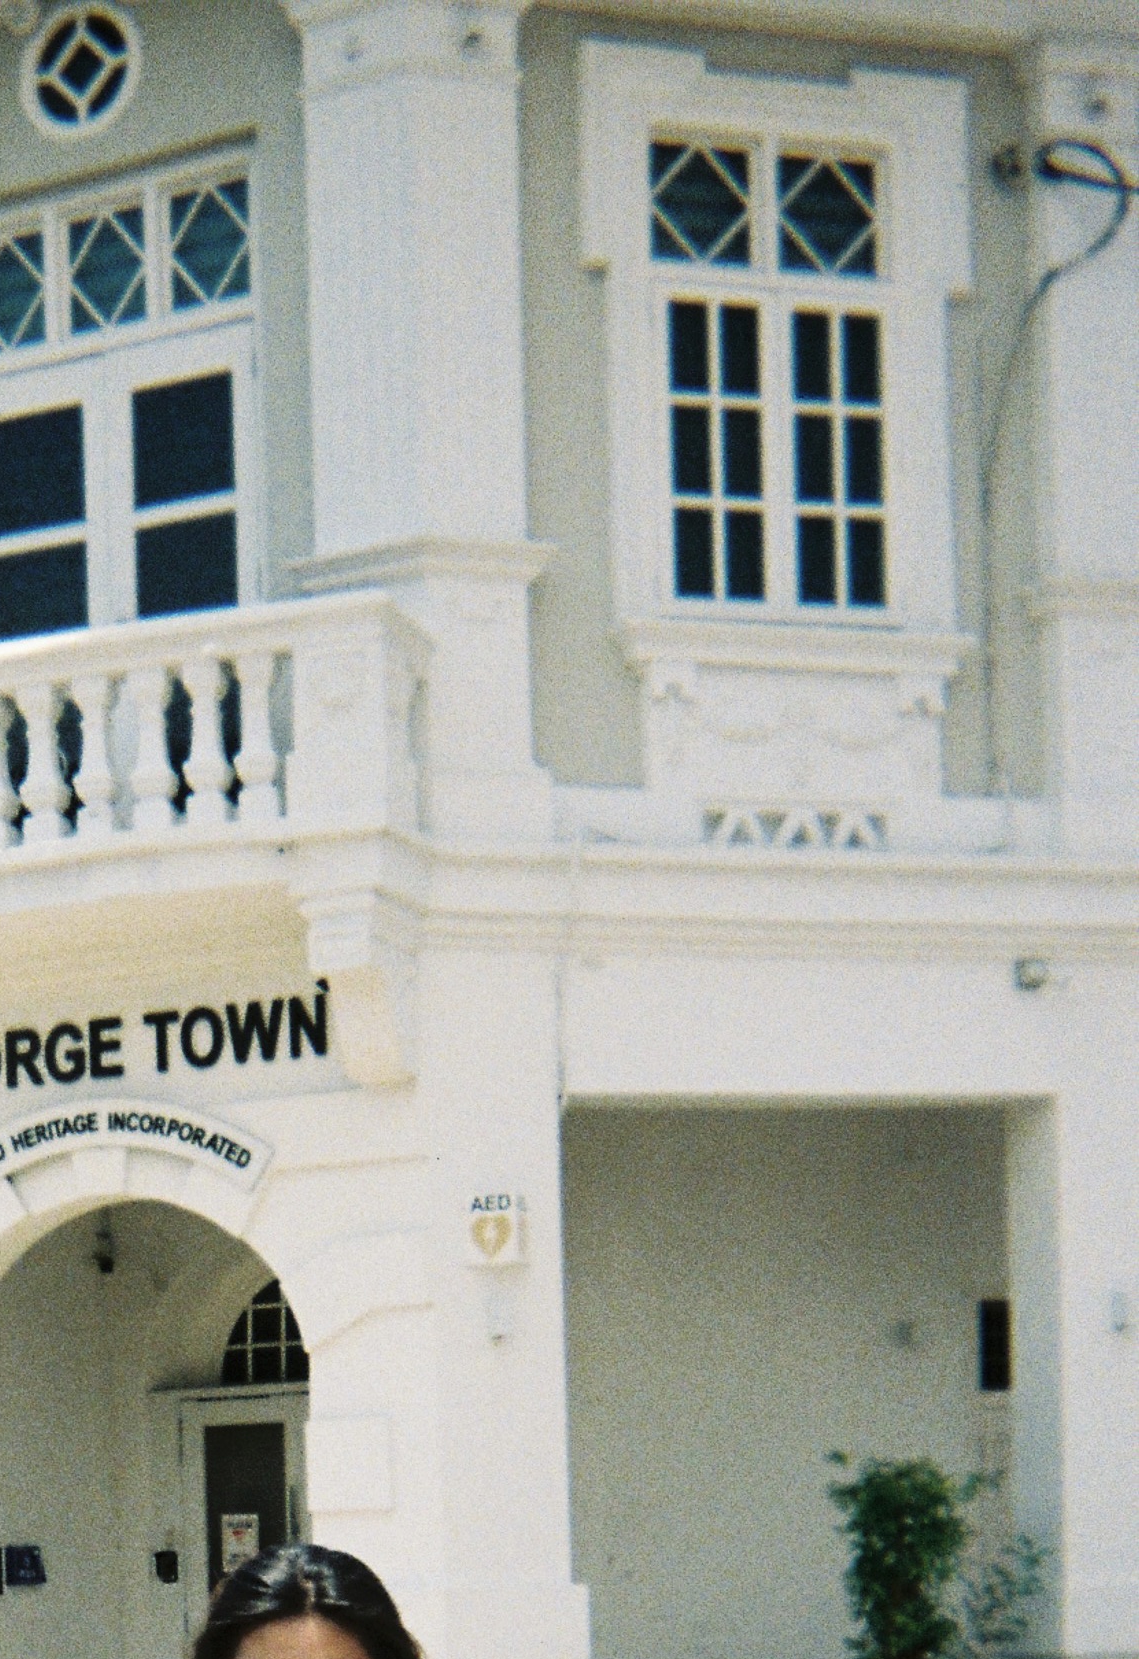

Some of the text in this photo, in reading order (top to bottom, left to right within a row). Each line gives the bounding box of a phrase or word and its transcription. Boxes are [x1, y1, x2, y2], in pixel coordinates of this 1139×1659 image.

[143, 993, 329, 1073] TOWN
[11, 1111, 98, 1154] HERITAGE
[107, 1111, 252, 1170] INCORPORATED
[470, 1194, 511, 1212] AED
